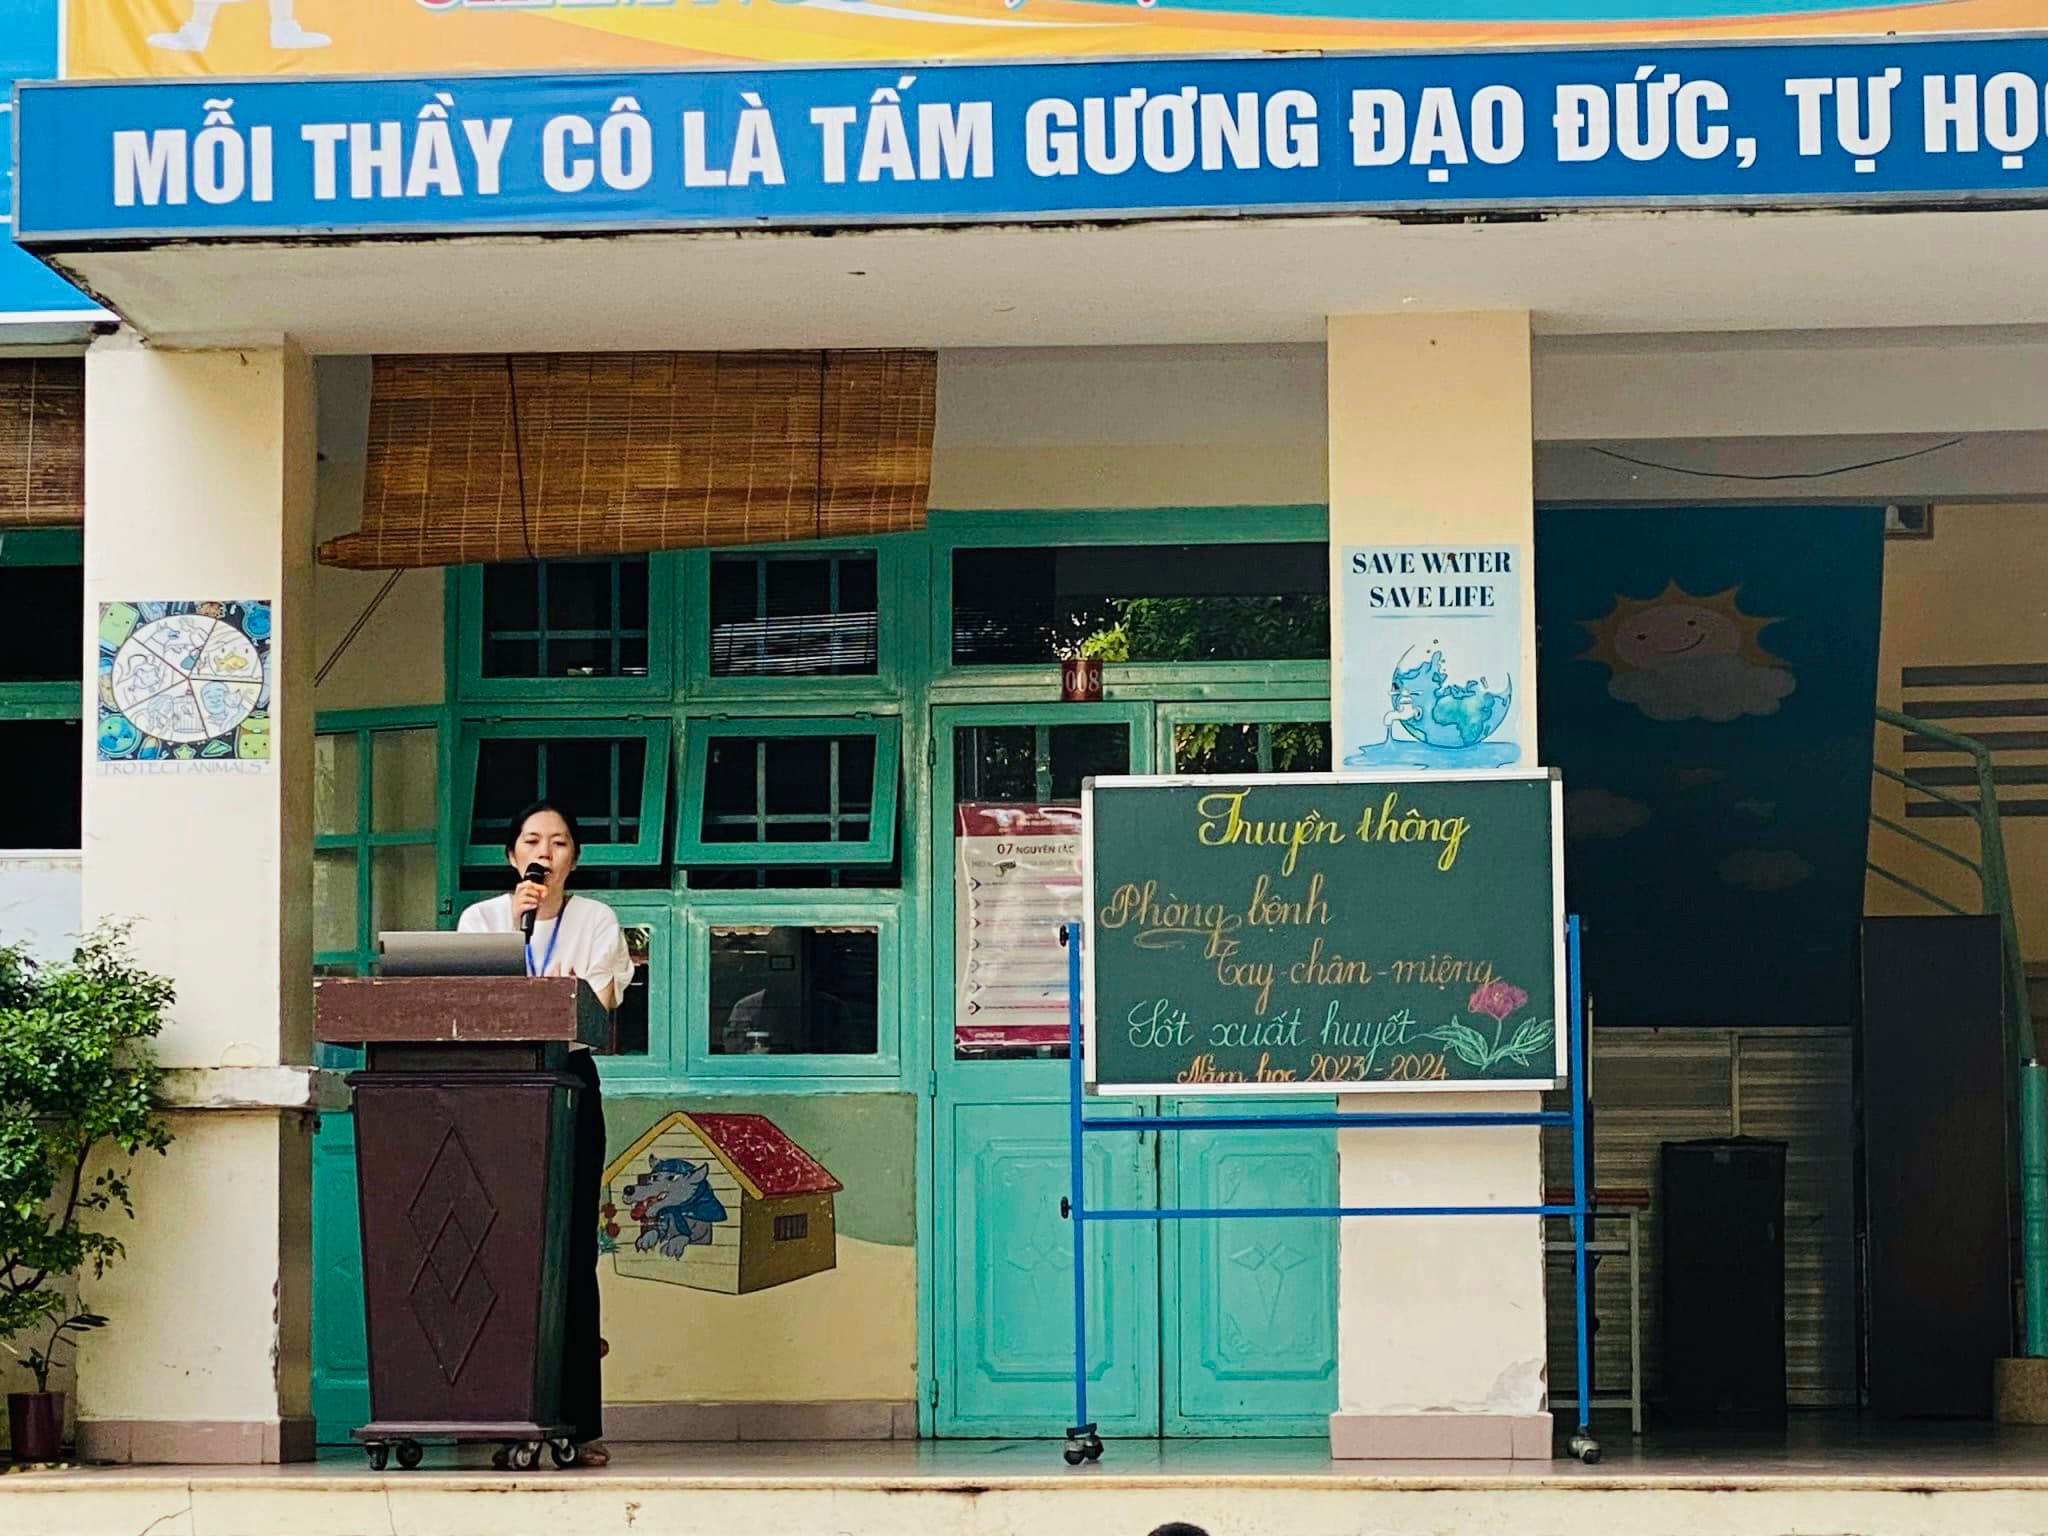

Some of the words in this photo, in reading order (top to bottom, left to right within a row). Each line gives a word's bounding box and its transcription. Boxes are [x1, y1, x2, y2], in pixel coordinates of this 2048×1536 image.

[113, 97, 273, 207] MỖI
[302, 93, 512, 200] THẦY
[543, 97, 653, 193] CÔ
[683, 92, 786, 187] LÀ
[810, 76, 993, 183] TẤM
[1025, 86, 1319, 177] GƯƠNG
[1349, 86, 1525, 182] ĐẠO
[1552, 65, 1756, 168] ĐỨC,
[1785, 67, 1902, 173] TỰ
[1923, 72, 2048, 169] HỌ
[1352, 552, 1415, 574] SAVE
[1422, 551, 1511, 573] WATER
[1370, 586, 1432, 608] SAVE
[1439, 586, 1494, 607] LIFE
[1066, 669, 1100, 692] 008
[1198, 787, 1345, 877] Truyền
[1356, 792, 1471, 871] thông
[997, 843, 1014, 855] 07
[1100, 880, 1242, 959] Phòng
[1248, 874, 1335, 932] bệnh
[1127, 999, 1194, 1048] Sốt
[1210, 1008, 1304, 1048] xuất
[1320, 1000, 1416, 1078] huyết
[1177, 1053, 1248, 1083] Năm
